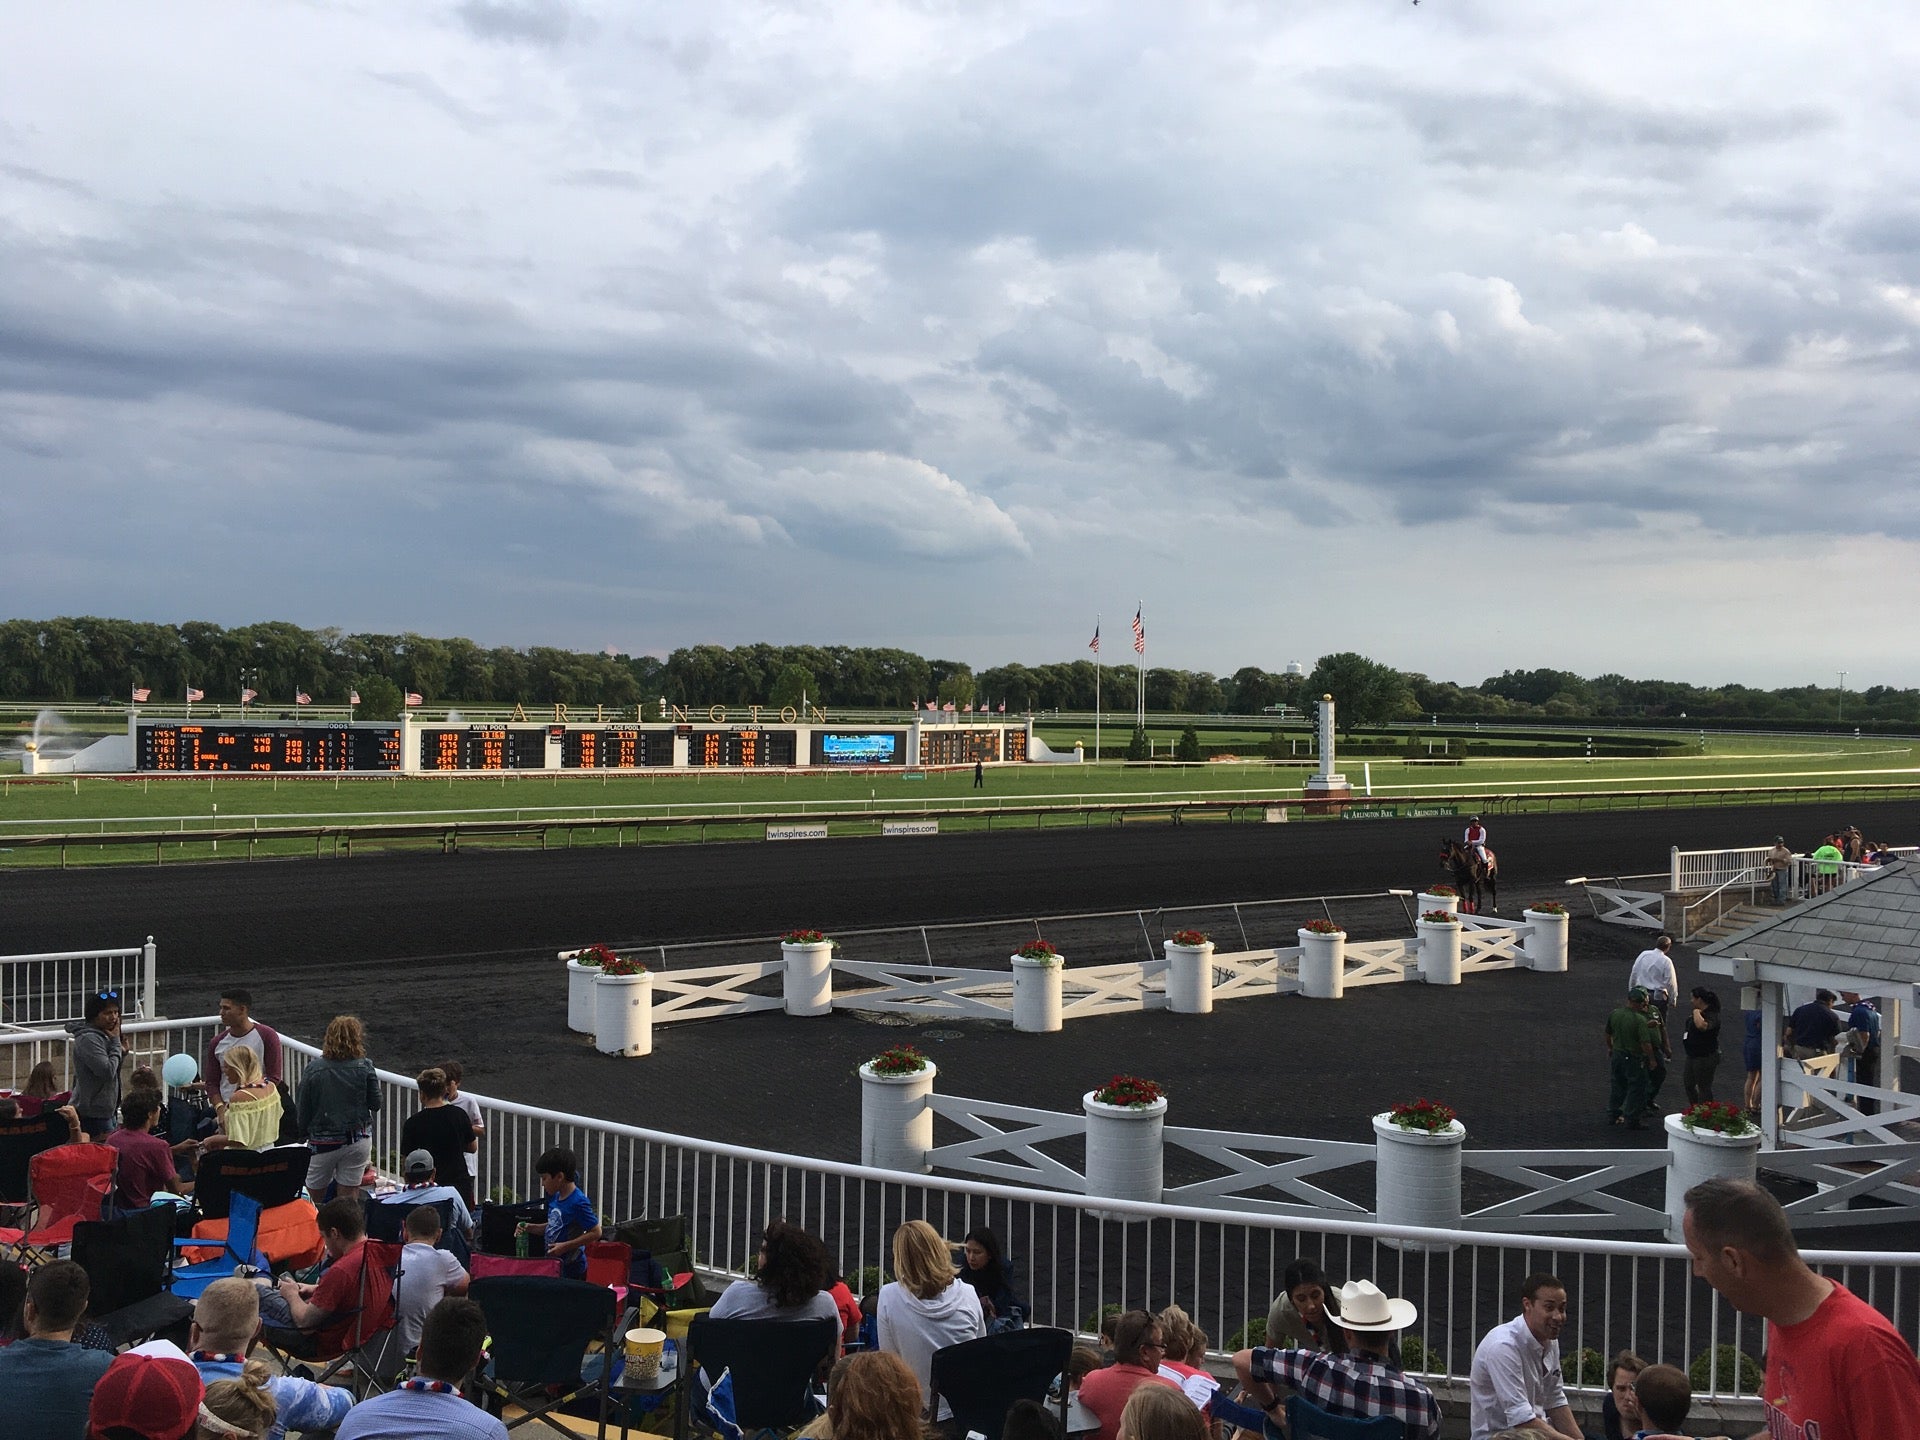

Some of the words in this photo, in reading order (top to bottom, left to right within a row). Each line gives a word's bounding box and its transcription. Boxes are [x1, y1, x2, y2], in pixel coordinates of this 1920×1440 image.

[511, 702, 828, 723] ARLINGTON
[1351, 810, 1380, 819] ARLINGTON
[1381, 809, 1393, 818] PARK
[1414, 809, 1439, 817] ARLINGTON
[1440, 807, 1453, 816] PARK
[768, 827, 826, 839] twinspires.com
[883, 824, 937, 835] twinspires.com
